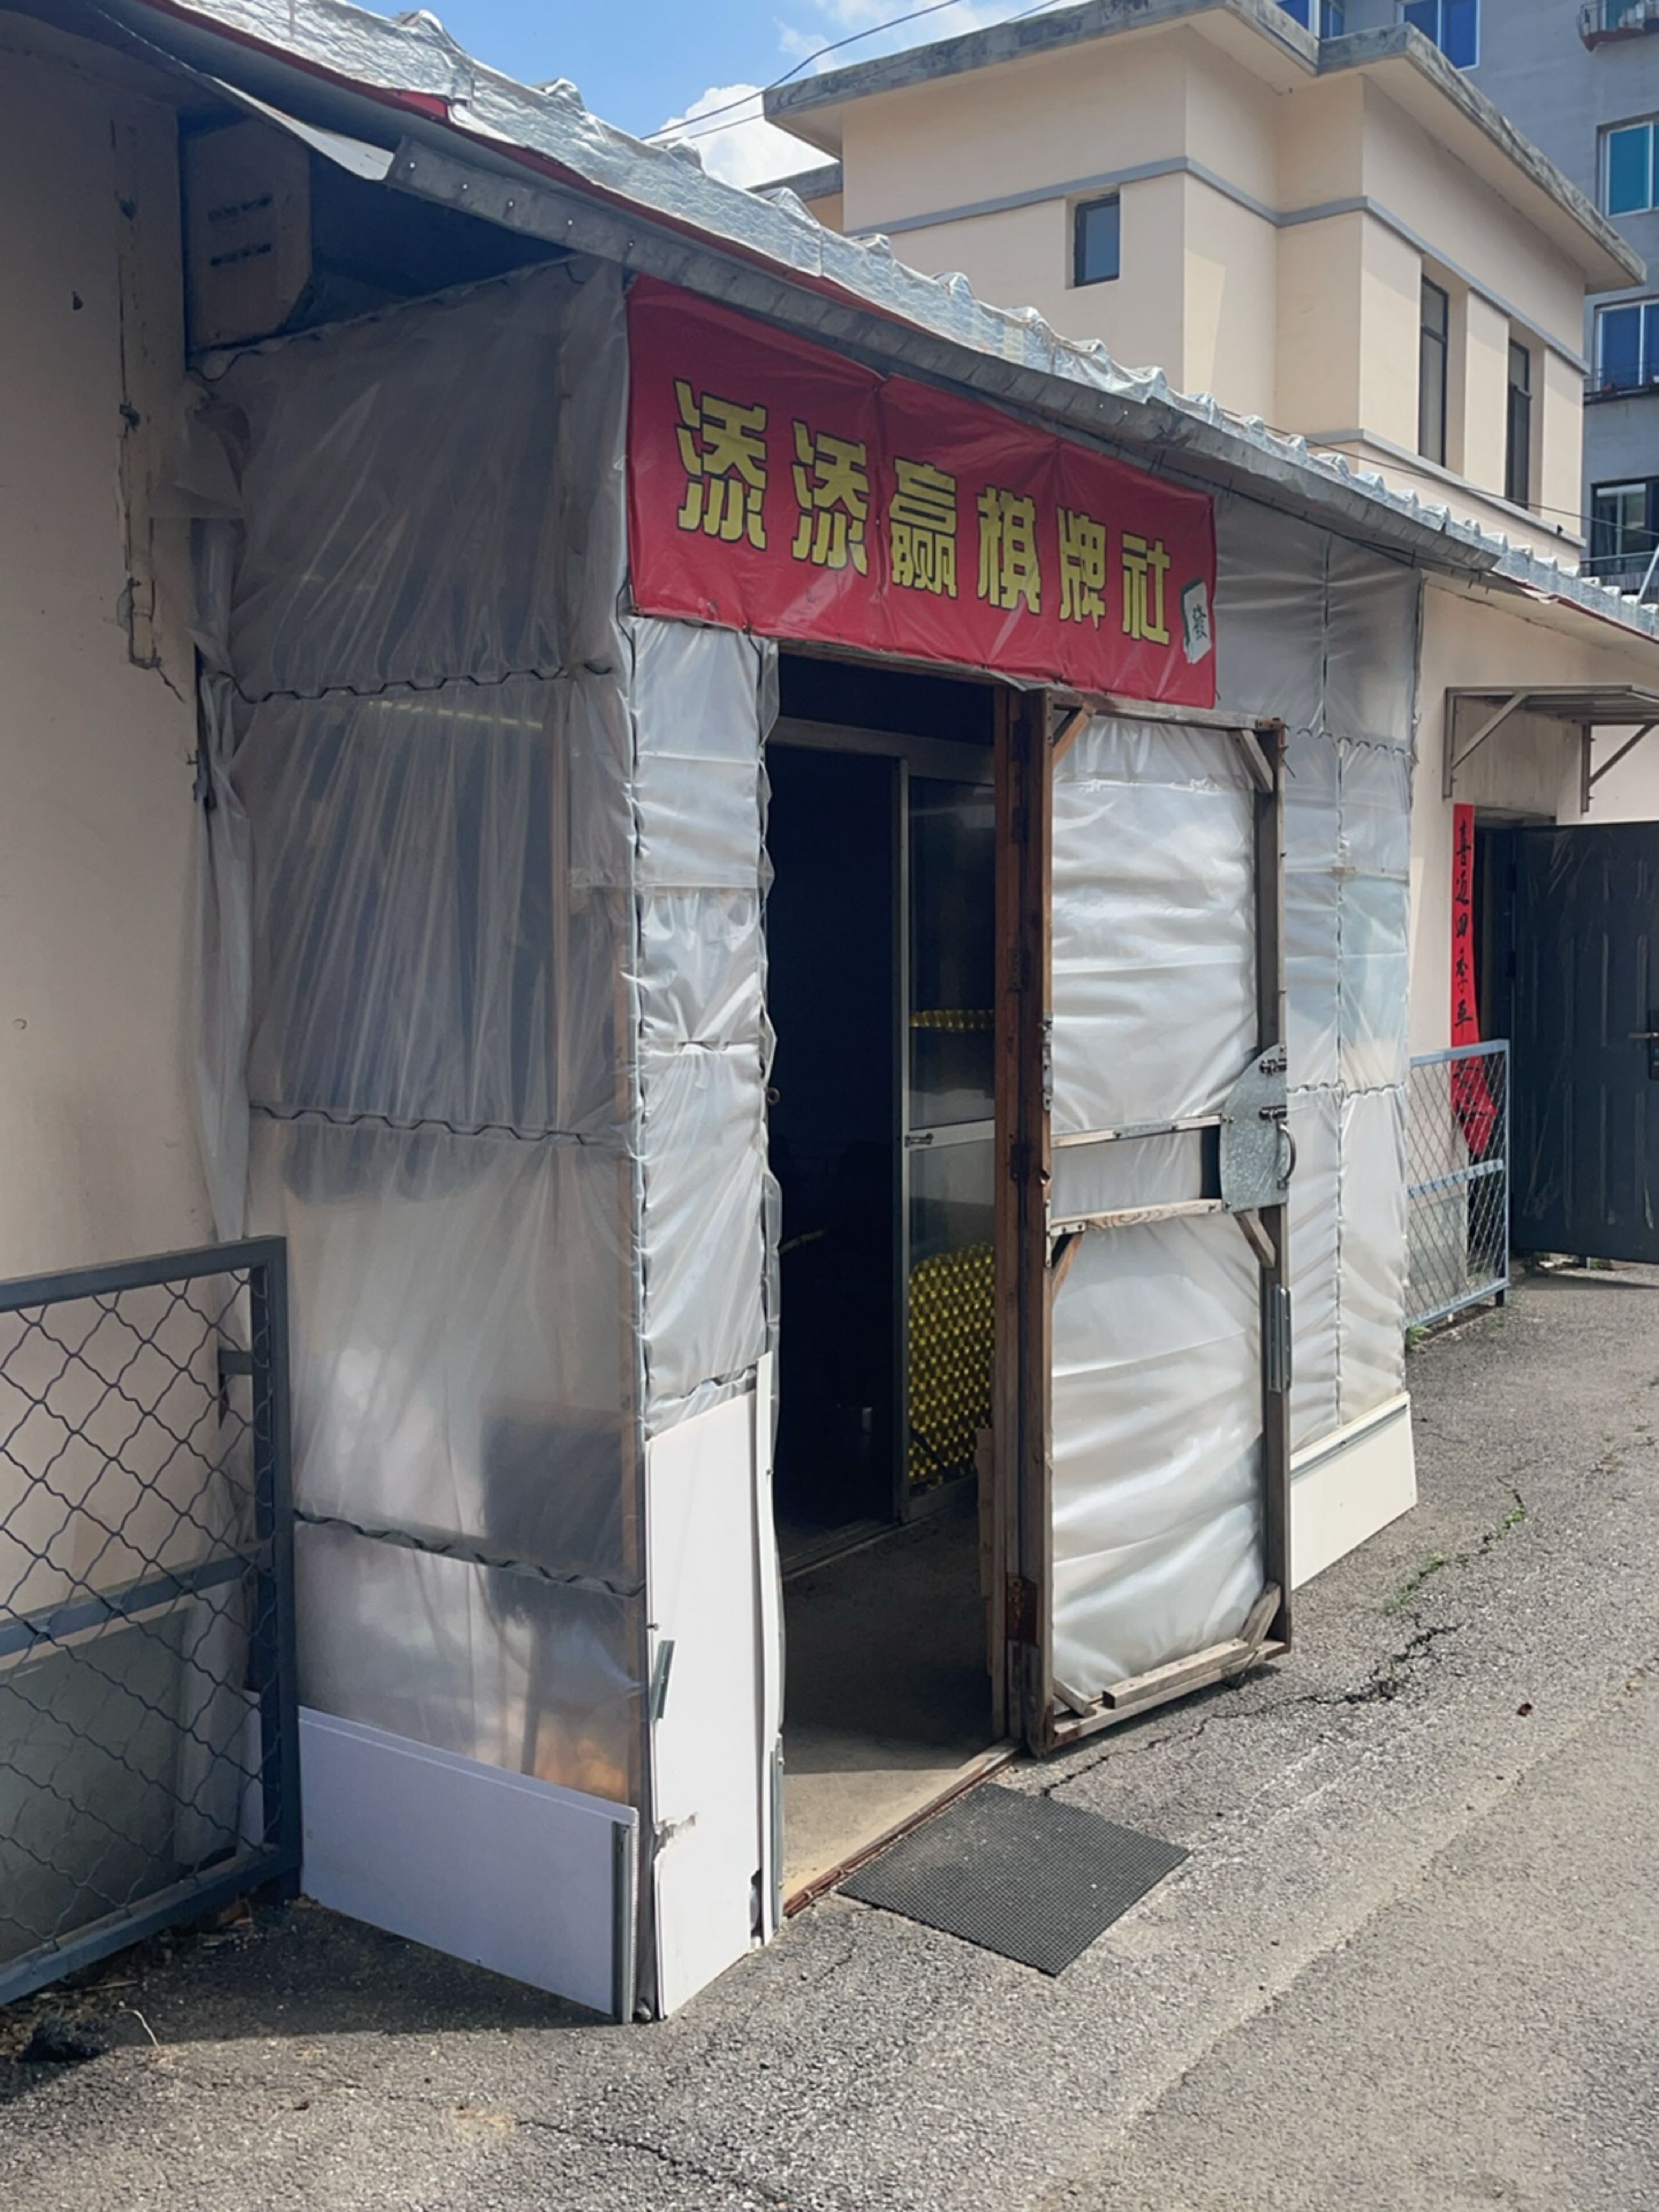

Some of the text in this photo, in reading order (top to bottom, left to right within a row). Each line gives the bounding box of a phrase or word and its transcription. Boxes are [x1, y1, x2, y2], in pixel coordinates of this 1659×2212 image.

[673, 378, 1171, 645] 添添赢棋牌社
